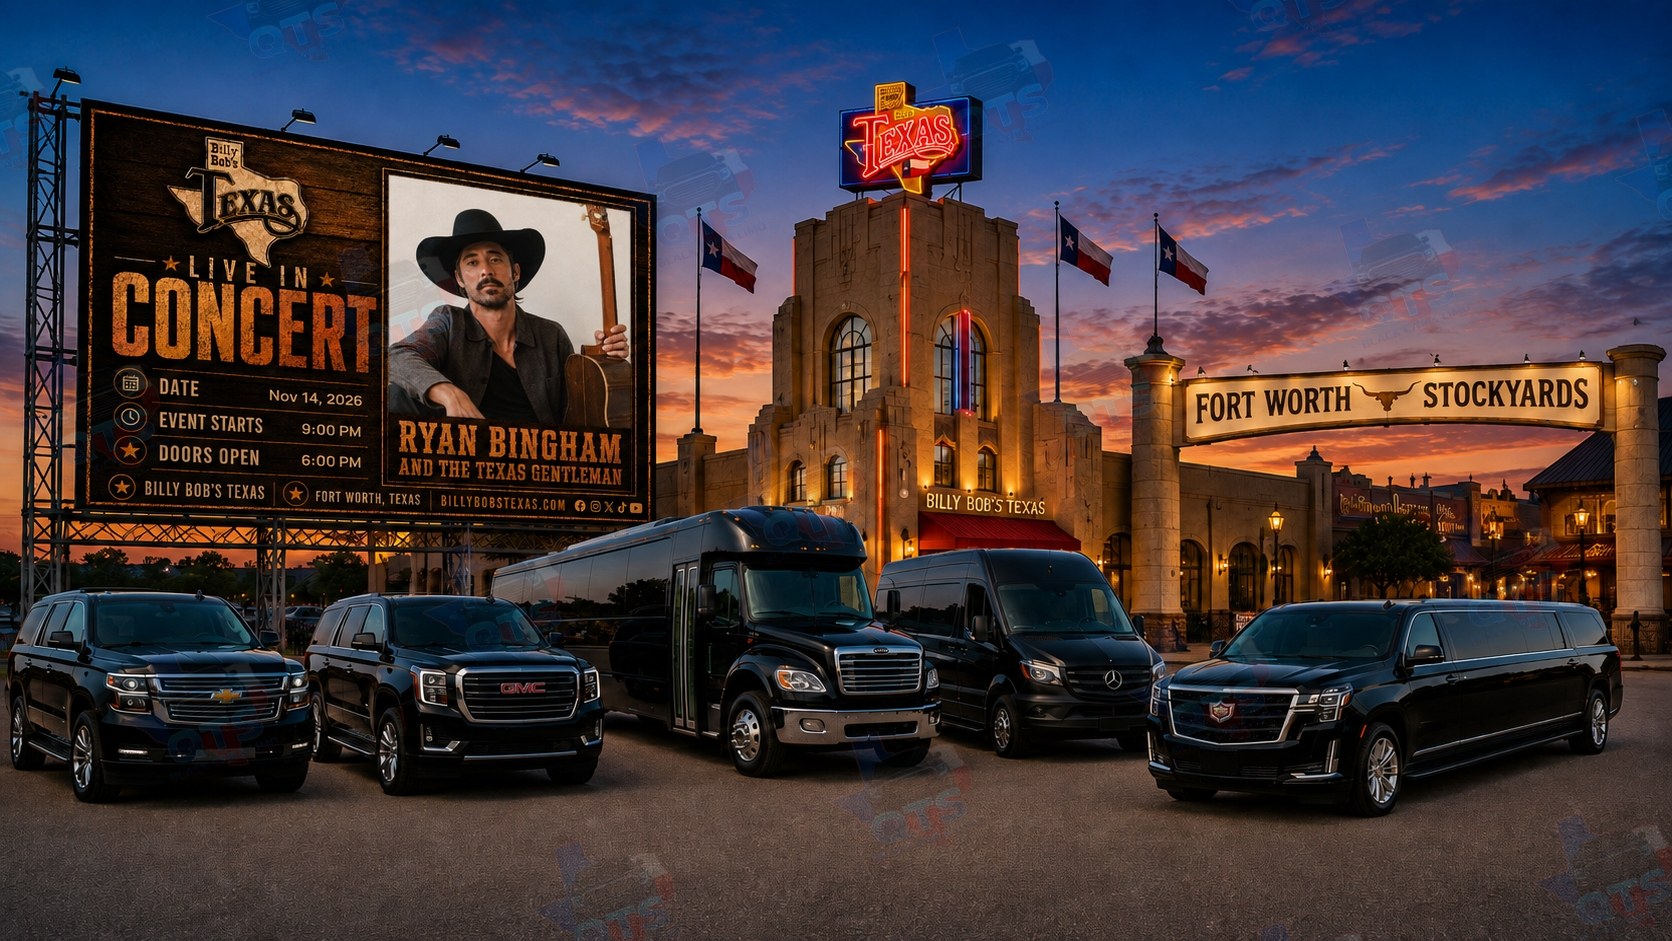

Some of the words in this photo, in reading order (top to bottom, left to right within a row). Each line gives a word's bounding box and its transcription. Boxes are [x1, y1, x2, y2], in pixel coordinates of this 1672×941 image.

[210, 142, 238, 160] Billy
[852, 114, 955, 178] TEXAS
[210, 154, 238, 168] Bob's
[185, 167, 304, 236] TEXAS
[189, 255, 257, 284] LIVE
[280, 264, 308, 289] IN
[112, 271, 377, 373] CONCERT
[159, 377, 200, 397] DATE
[269, 389, 298, 402] Nov
[302, 391, 323, 406] 14,
[326, 393, 363, 407] 2026
[1195, 390, 1255, 424] FORT
[1263, 385, 1352, 417] WORTH
[1423, 376, 1589, 410] STOCKYARDS
[159, 411, 206, 431] EVENT
[211, 415, 264, 434] STARTS
[302, 423, 336, 436] 9:00
[339, 425, 361, 438] PM
[398, 419, 478, 457] RYAN
[488, 425, 622, 464] BINGHAM
[159, 444, 212, 464] DOORS
[219, 447, 260, 466] OPEN
[302, 454, 336, 468] 6:00
[339, 456, 361, 469] PM
[398, 457, 434, 477] AND
[438, 460, 470, 479] THE
[476, 461, 526, 482] TEXAS
[531, 464, 622, 486] GENTLEMAN
[144, 480, 180, 498] BILLY
[185, 482, 222, 499] BOB'S
[227, 484, 265, 500] TEXAS
[315, 490, 341, 503] FORT
[344, 491, 385, 506] WORTH,
[389, 492, 421, 506] TEXAS
[440, 494, 566, 511] BILLYBOBSTEXAS.COM
[926, 492, 961, 511] BILLY
[966, 495, 1002, 513] BOB'S
[1006, 499, 1046, 515] TEXAS
[500, 681, 546, 694] GMC
